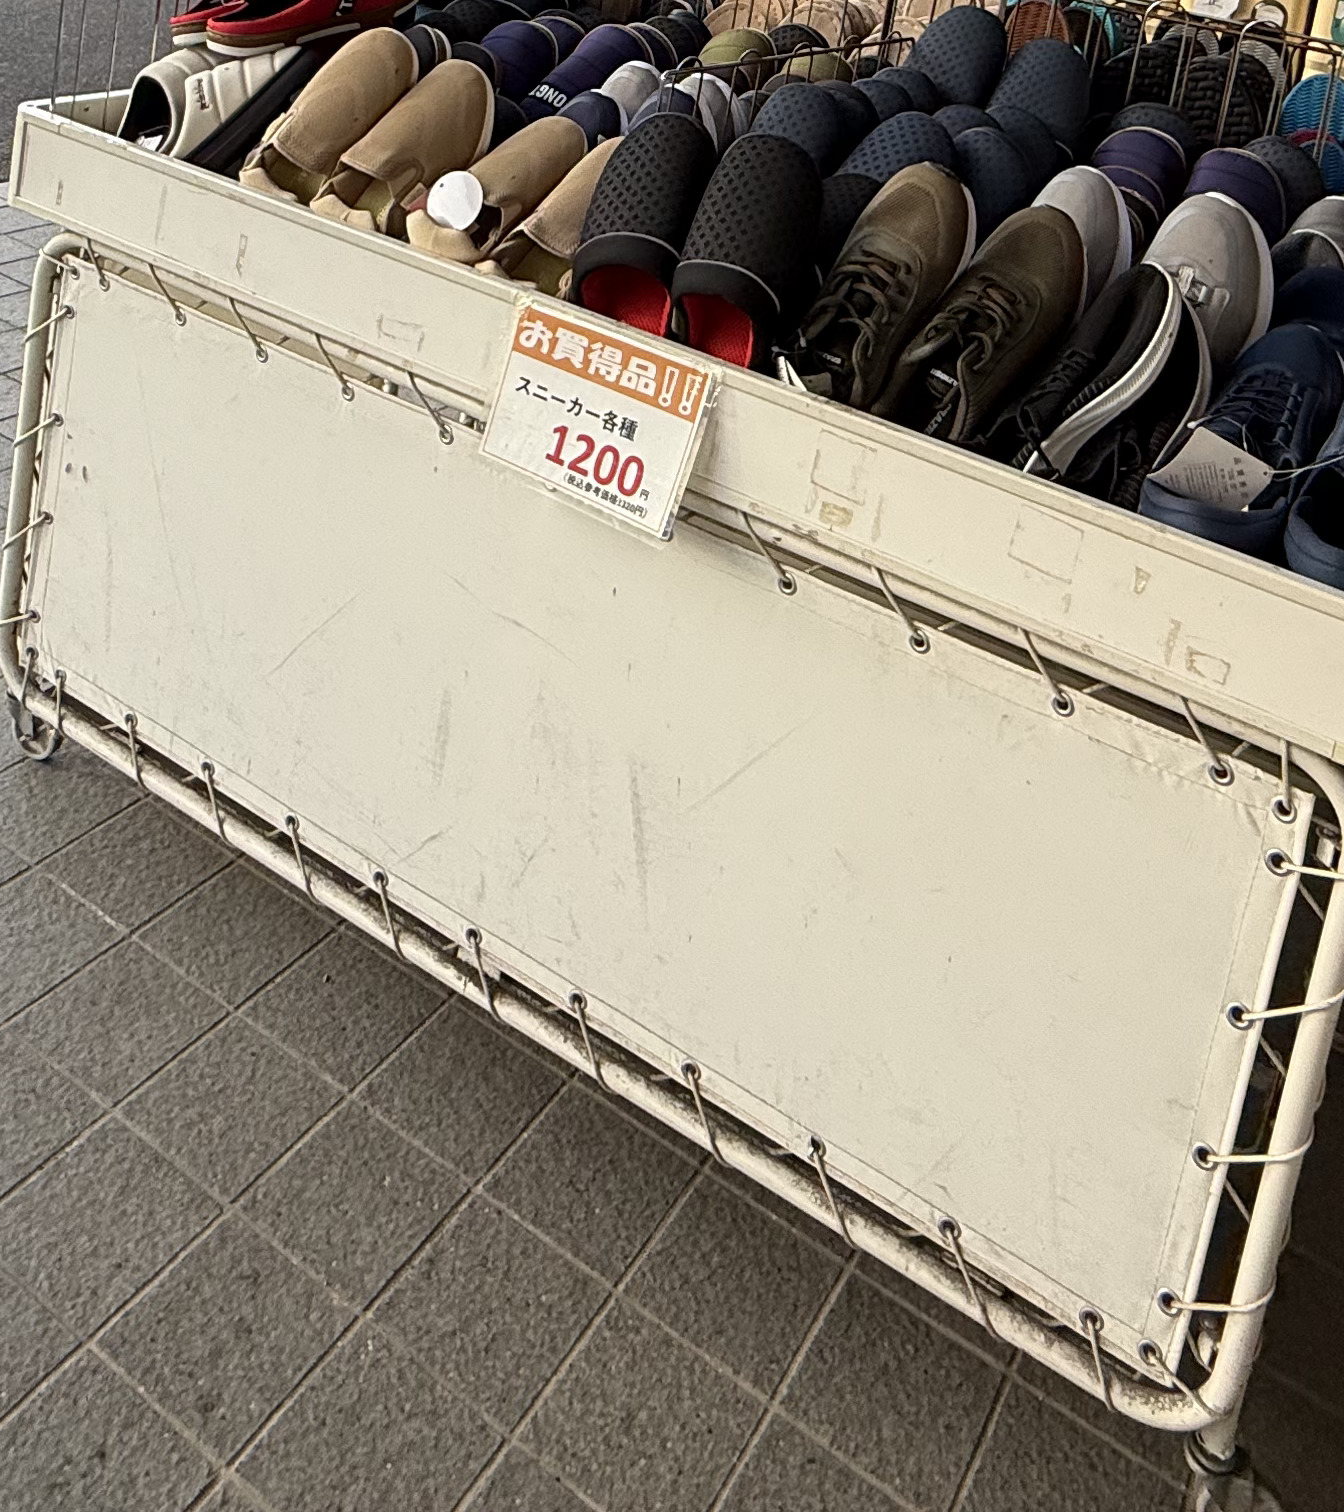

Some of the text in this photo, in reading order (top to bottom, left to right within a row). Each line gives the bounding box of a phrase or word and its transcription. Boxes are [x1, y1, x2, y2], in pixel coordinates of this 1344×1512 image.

[515, 376, 638, 442] スニーカー各種
